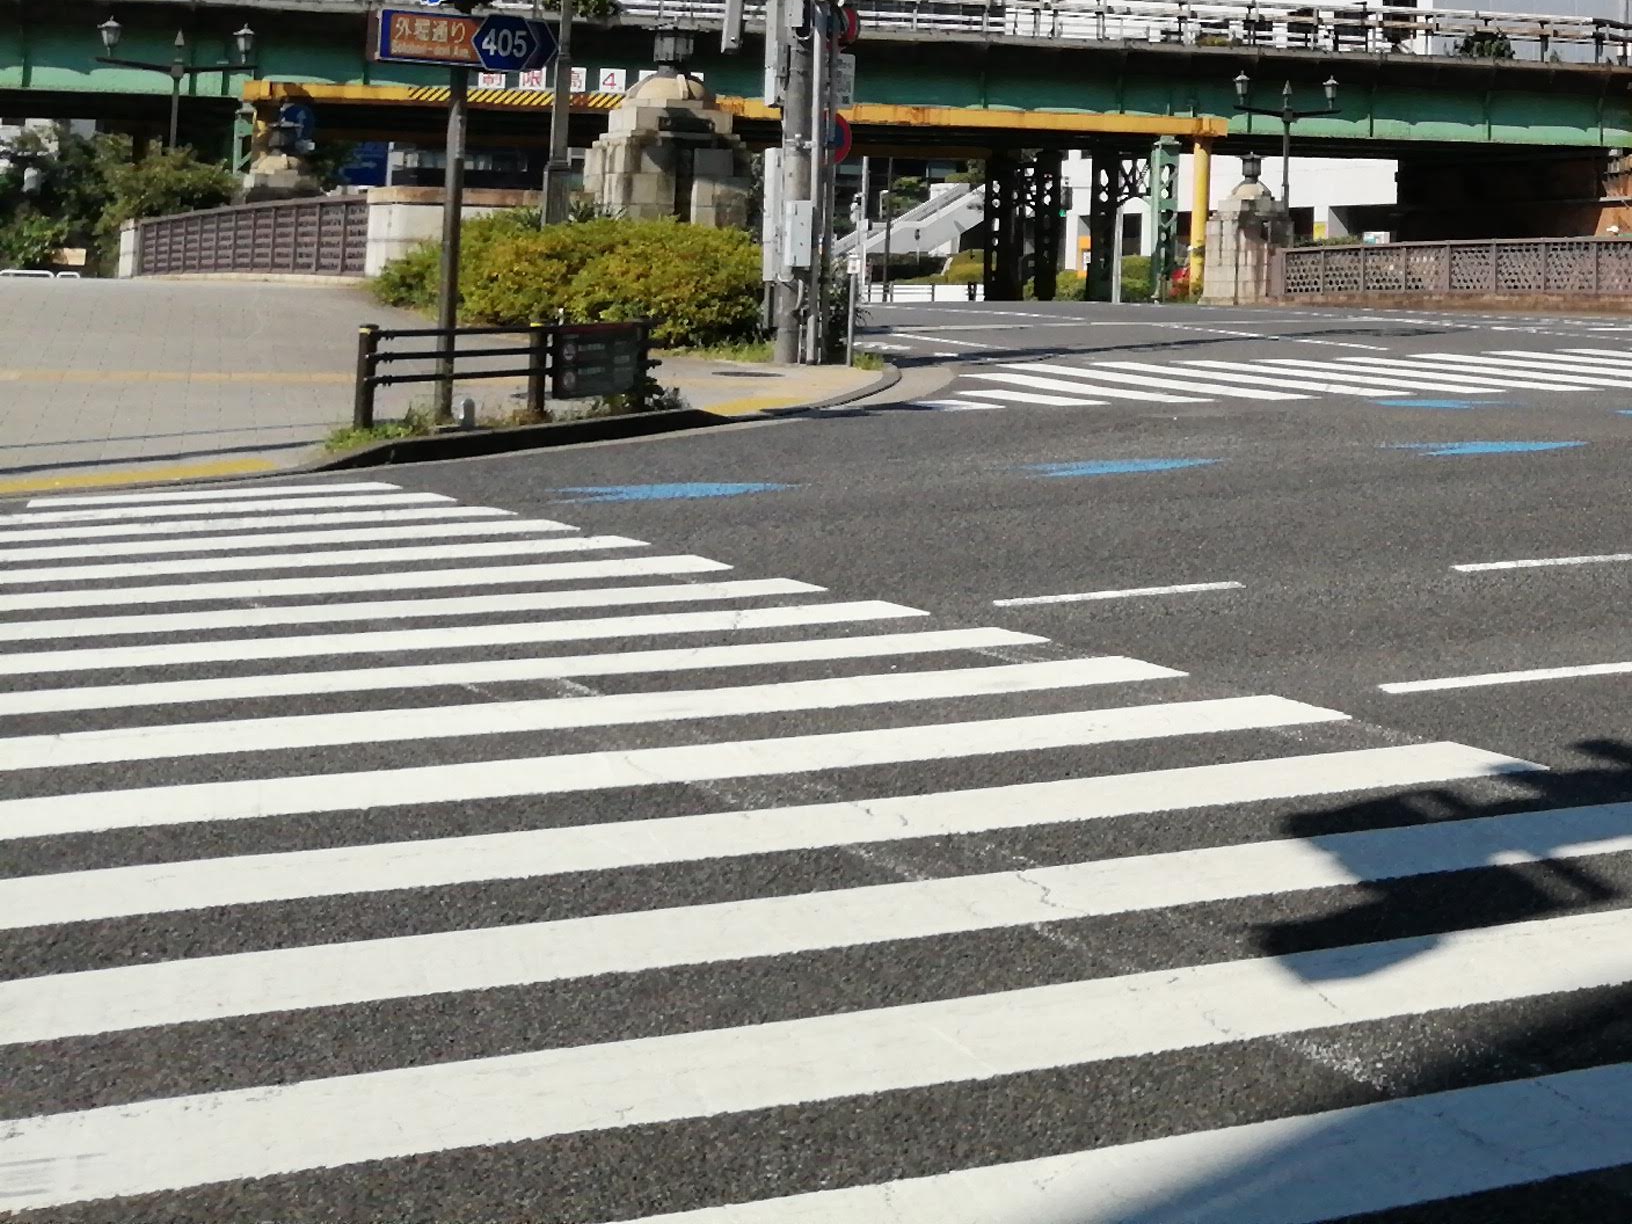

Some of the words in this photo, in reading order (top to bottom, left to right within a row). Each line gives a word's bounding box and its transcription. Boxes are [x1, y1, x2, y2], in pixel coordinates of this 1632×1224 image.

[395, 17, 466, 43] 外堀通り
[481, 28, 528, 58] 405
